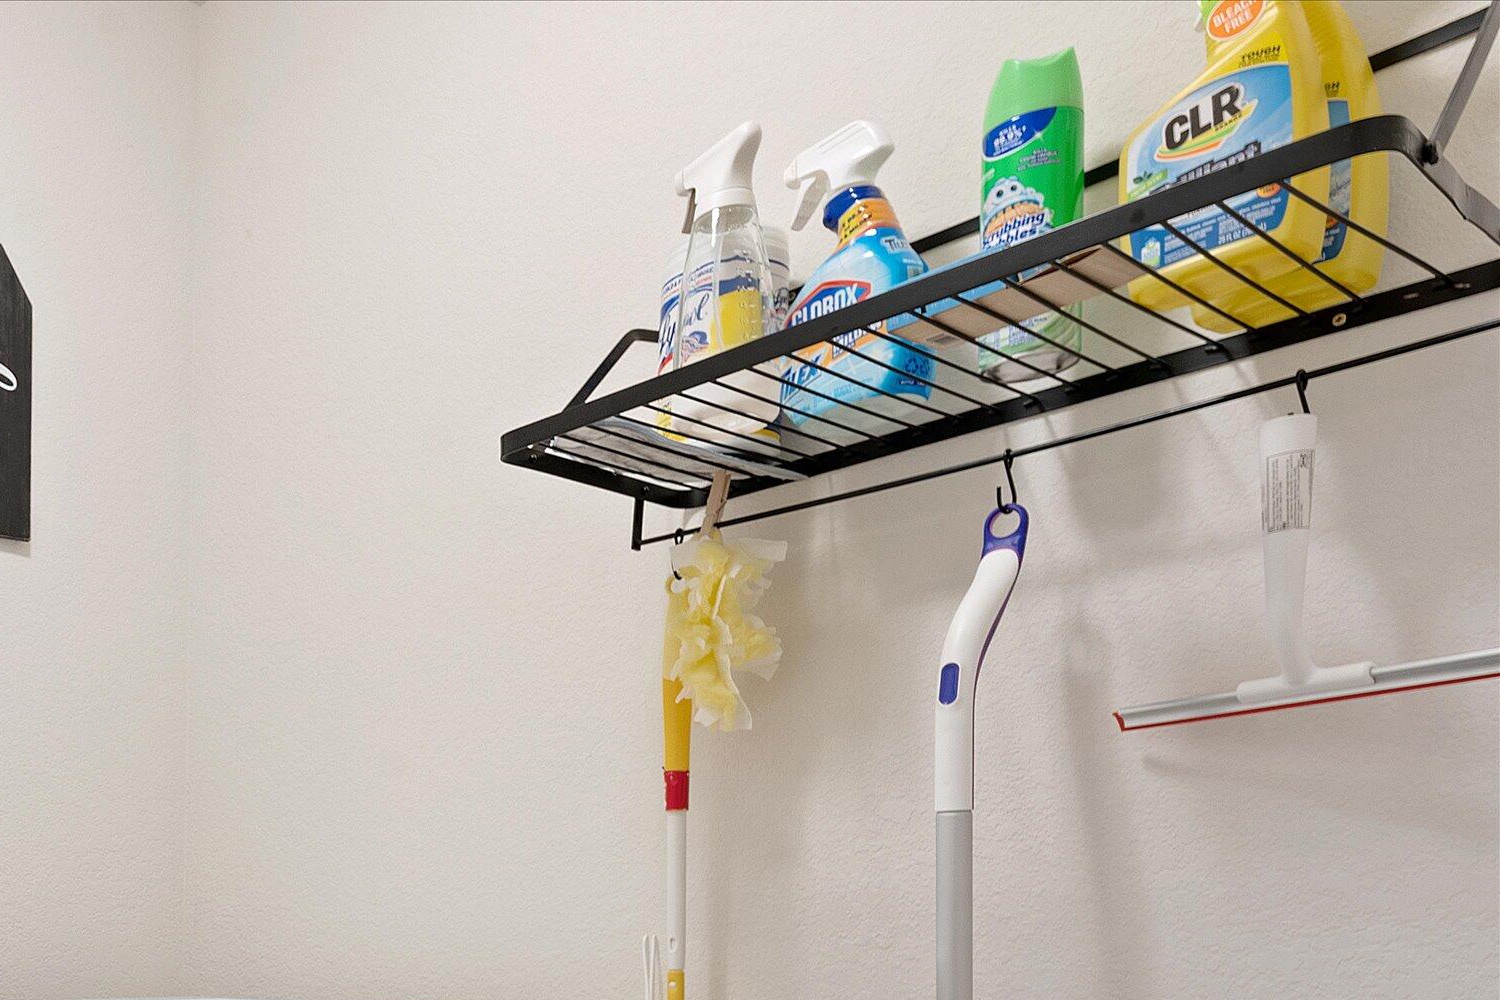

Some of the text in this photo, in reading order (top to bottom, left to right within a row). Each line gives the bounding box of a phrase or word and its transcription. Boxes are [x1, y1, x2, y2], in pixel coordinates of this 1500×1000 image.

[1212, 0, 1258, 27] BLEAC
[1223, 8, 1253, 33] FREE
[1164, 83, 1244, 151] CLR
[791, 283, 859, 327] CLOROX
